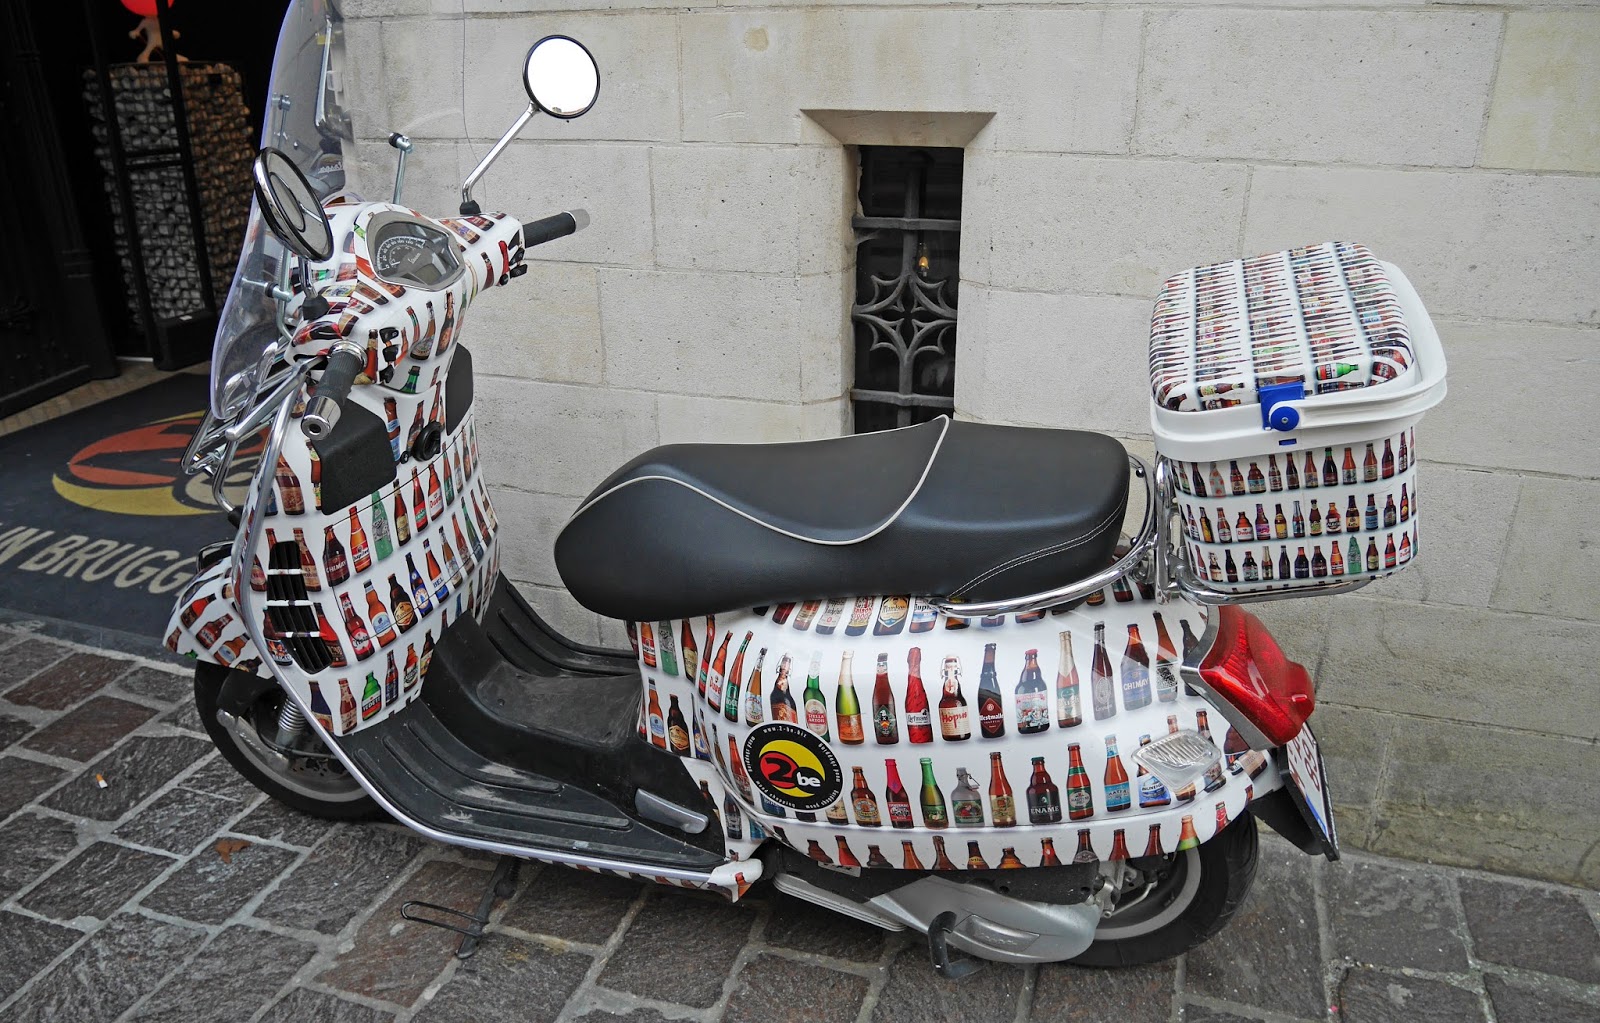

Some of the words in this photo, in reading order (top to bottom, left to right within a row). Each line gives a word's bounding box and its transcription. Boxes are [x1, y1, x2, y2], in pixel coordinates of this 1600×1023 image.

[17, 534, 199, 597] BRUGG
[1123, 678, 1149, 691] CHIMAY
[1030, 805, 1060, 814] ENAME
